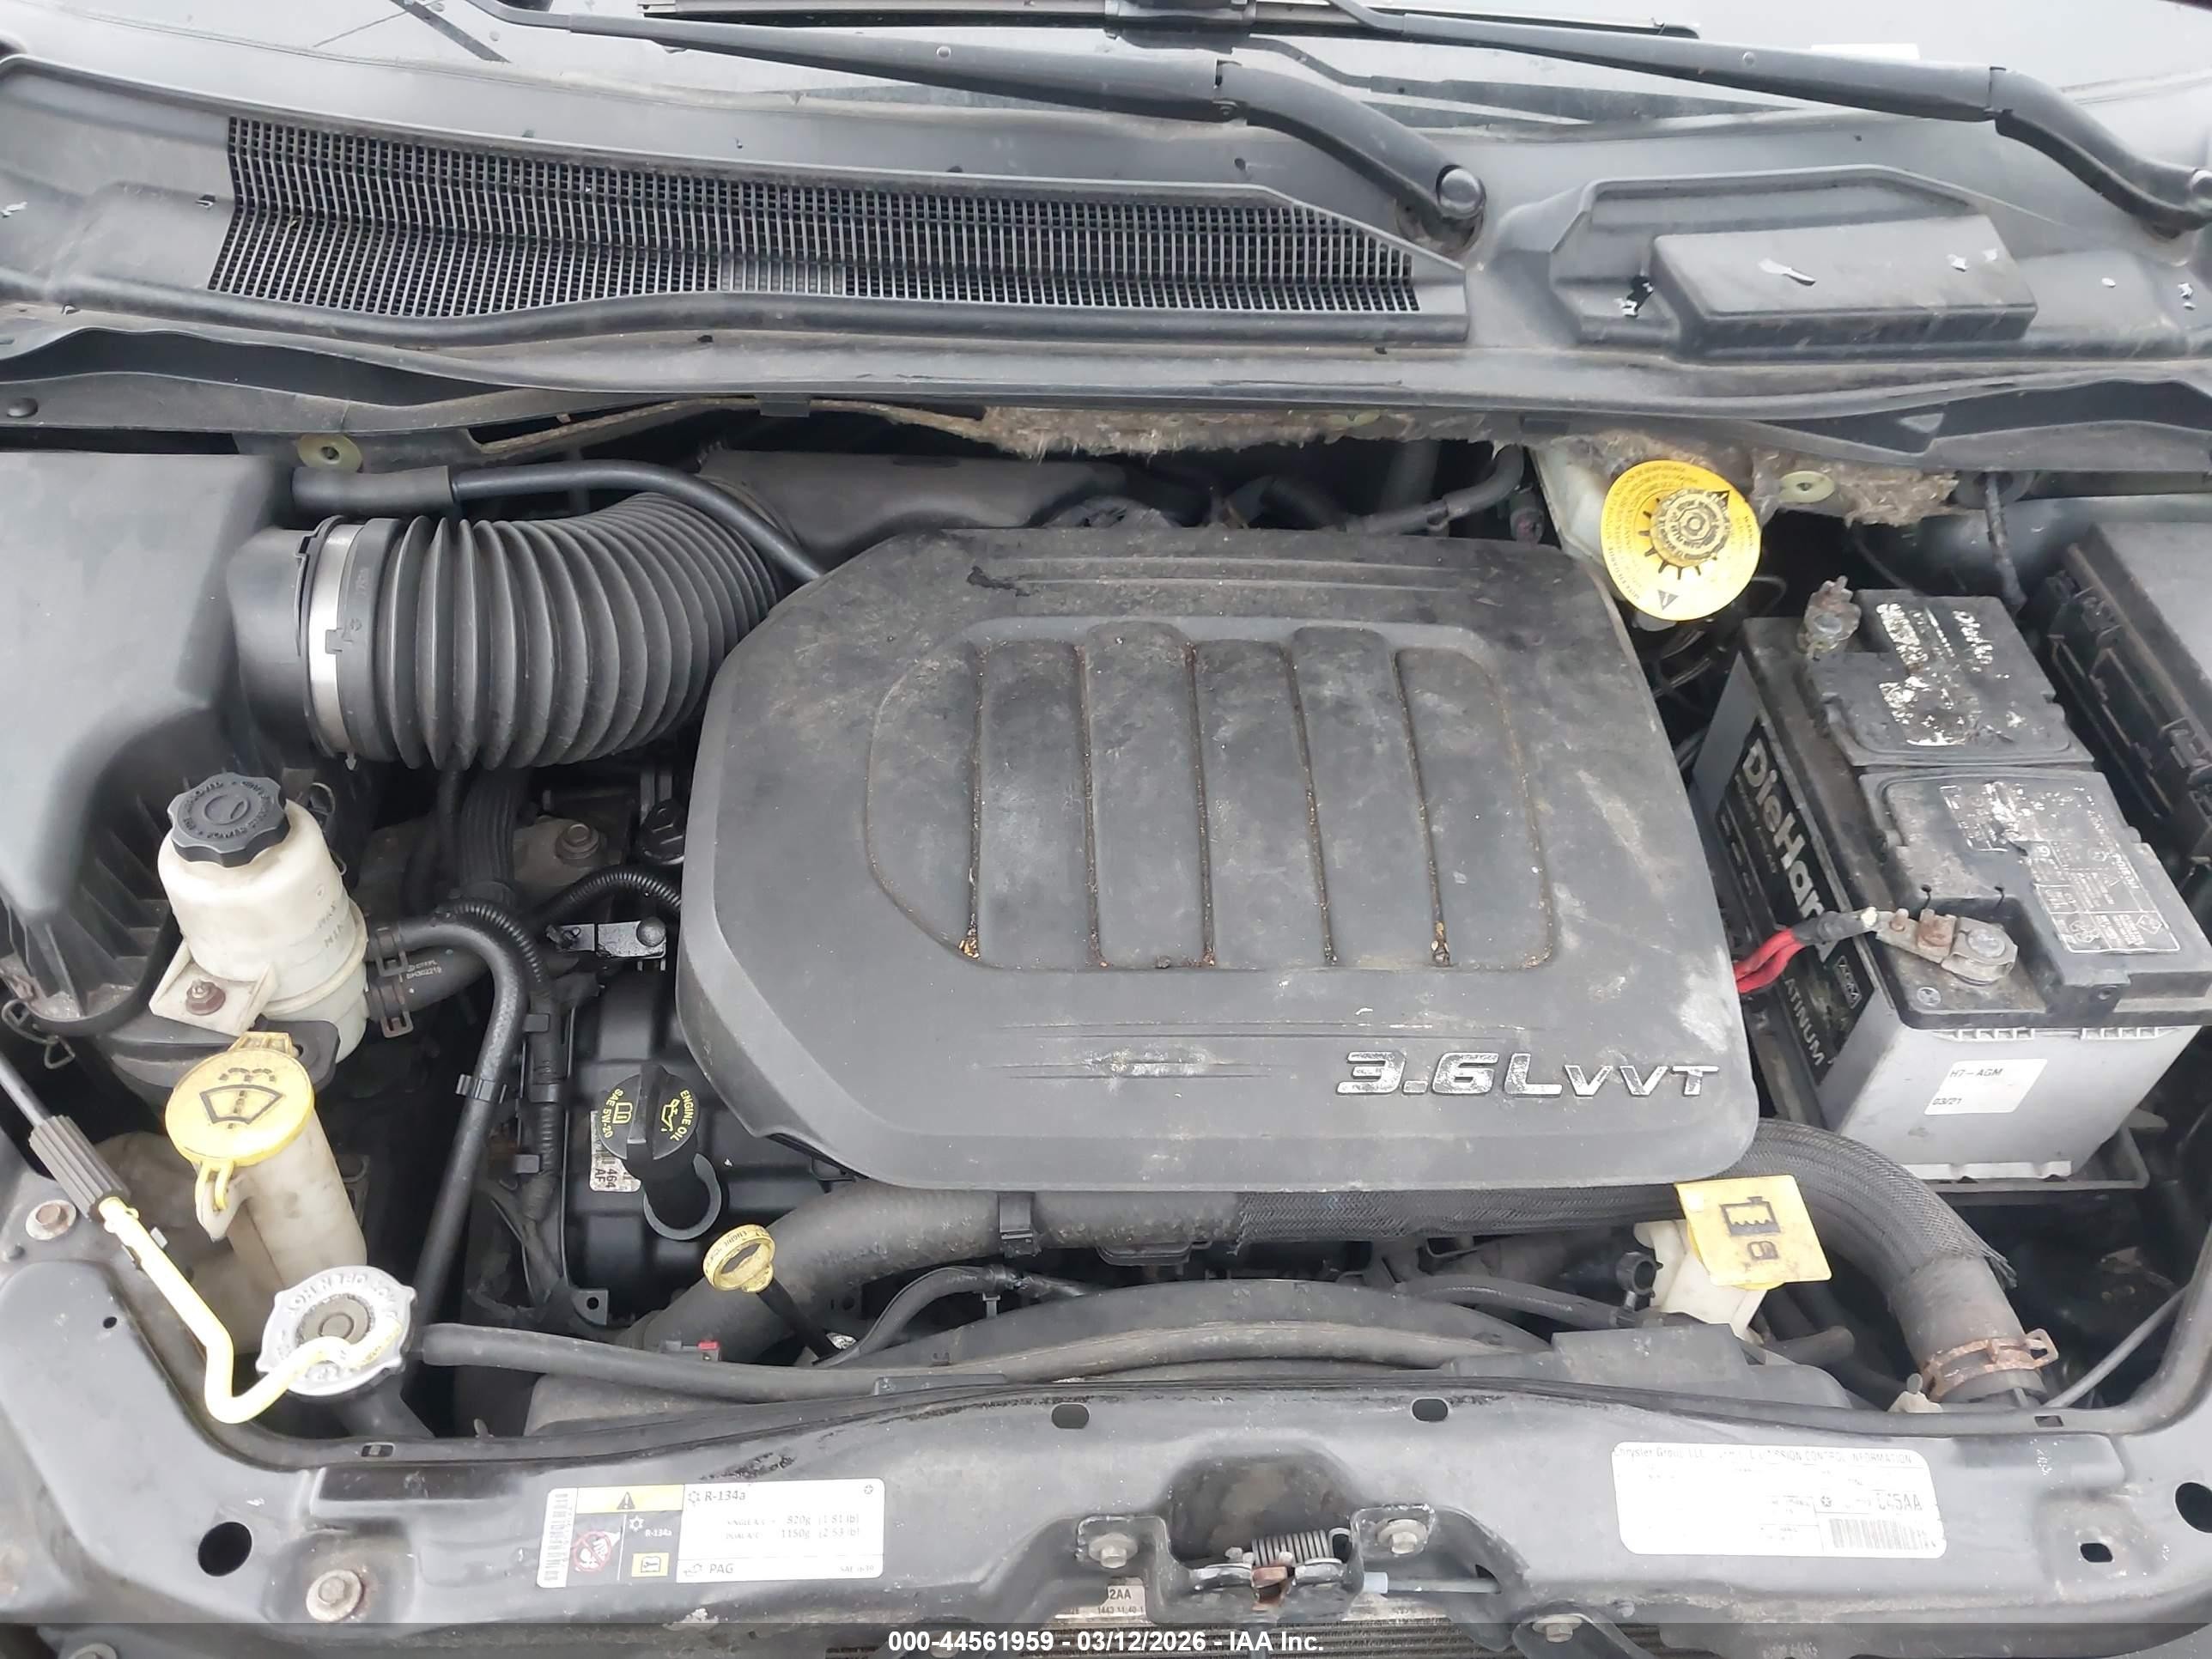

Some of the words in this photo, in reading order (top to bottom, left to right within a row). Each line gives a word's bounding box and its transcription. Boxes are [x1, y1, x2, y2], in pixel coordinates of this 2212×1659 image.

[1742, 738, 1826, 919] DieHar
[1784, 977, 1826, 1066] ATINUM
[605, 1088, 624, 1107] SAE
[680, 1090, 695, 1126] ENGINE
[601, 1108, 614, 1139] 5W-20
[670, 1127, 688, 1141] OIL
[704, 1490, 747, 1503] R-134a
[709, 1563, 735, 1574] PAG
